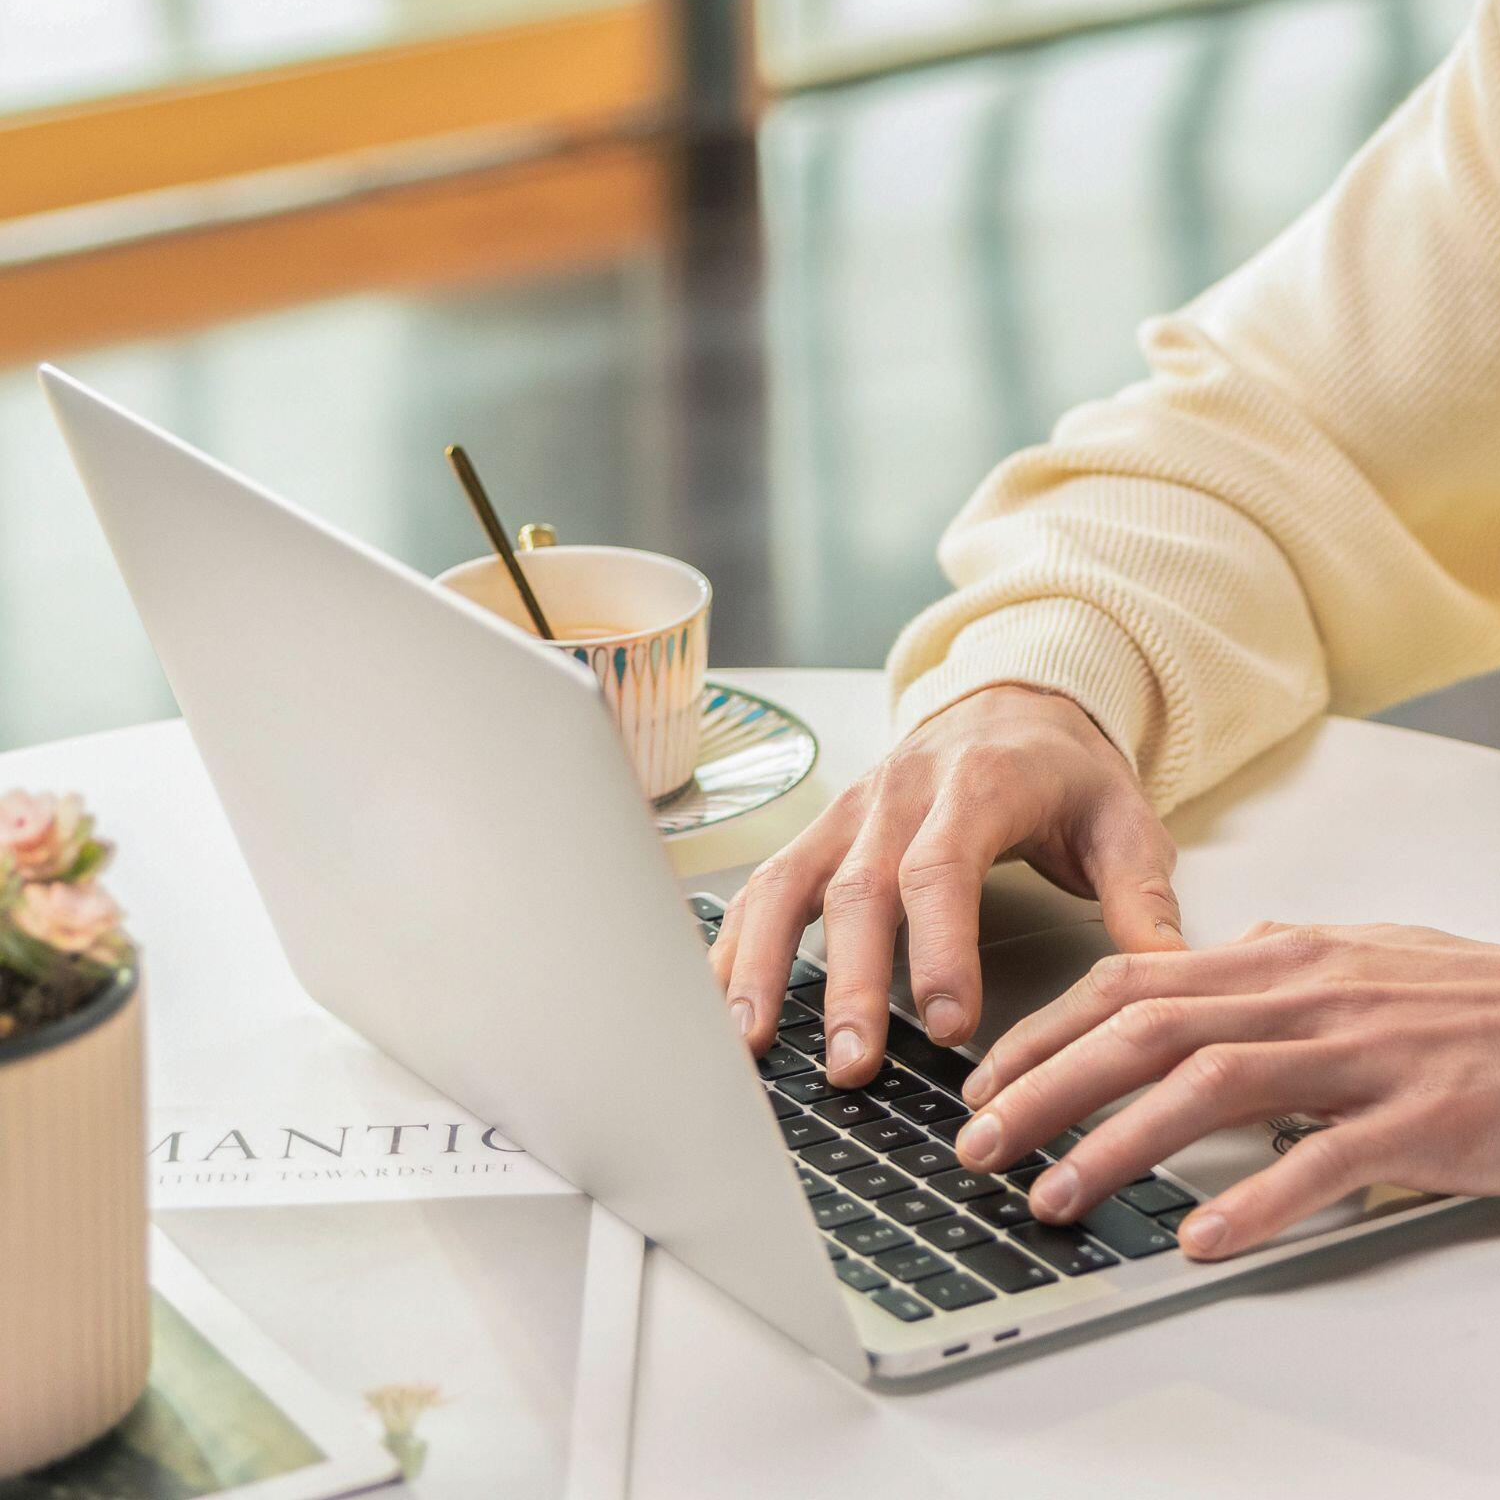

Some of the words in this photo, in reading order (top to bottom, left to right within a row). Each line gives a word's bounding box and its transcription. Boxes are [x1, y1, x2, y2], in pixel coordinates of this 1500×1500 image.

[805, 1082, 824, 1092] H
[843, 1105, 860, 1114] G
[919, 1102, 937, 1112] V
[792, 1126, 809, 1136] T
[880, 1130, 898, 1139] F
[831, 1150, 849, 1161] R
[919, 1154, 937, 1164] D
[276, 1165, 433, 1182] TOWARDS
[453, 1163, 514, 1174] LIFE
[868, 1176, 886, 1185] E
[959, 1179, 976, 1188] S
